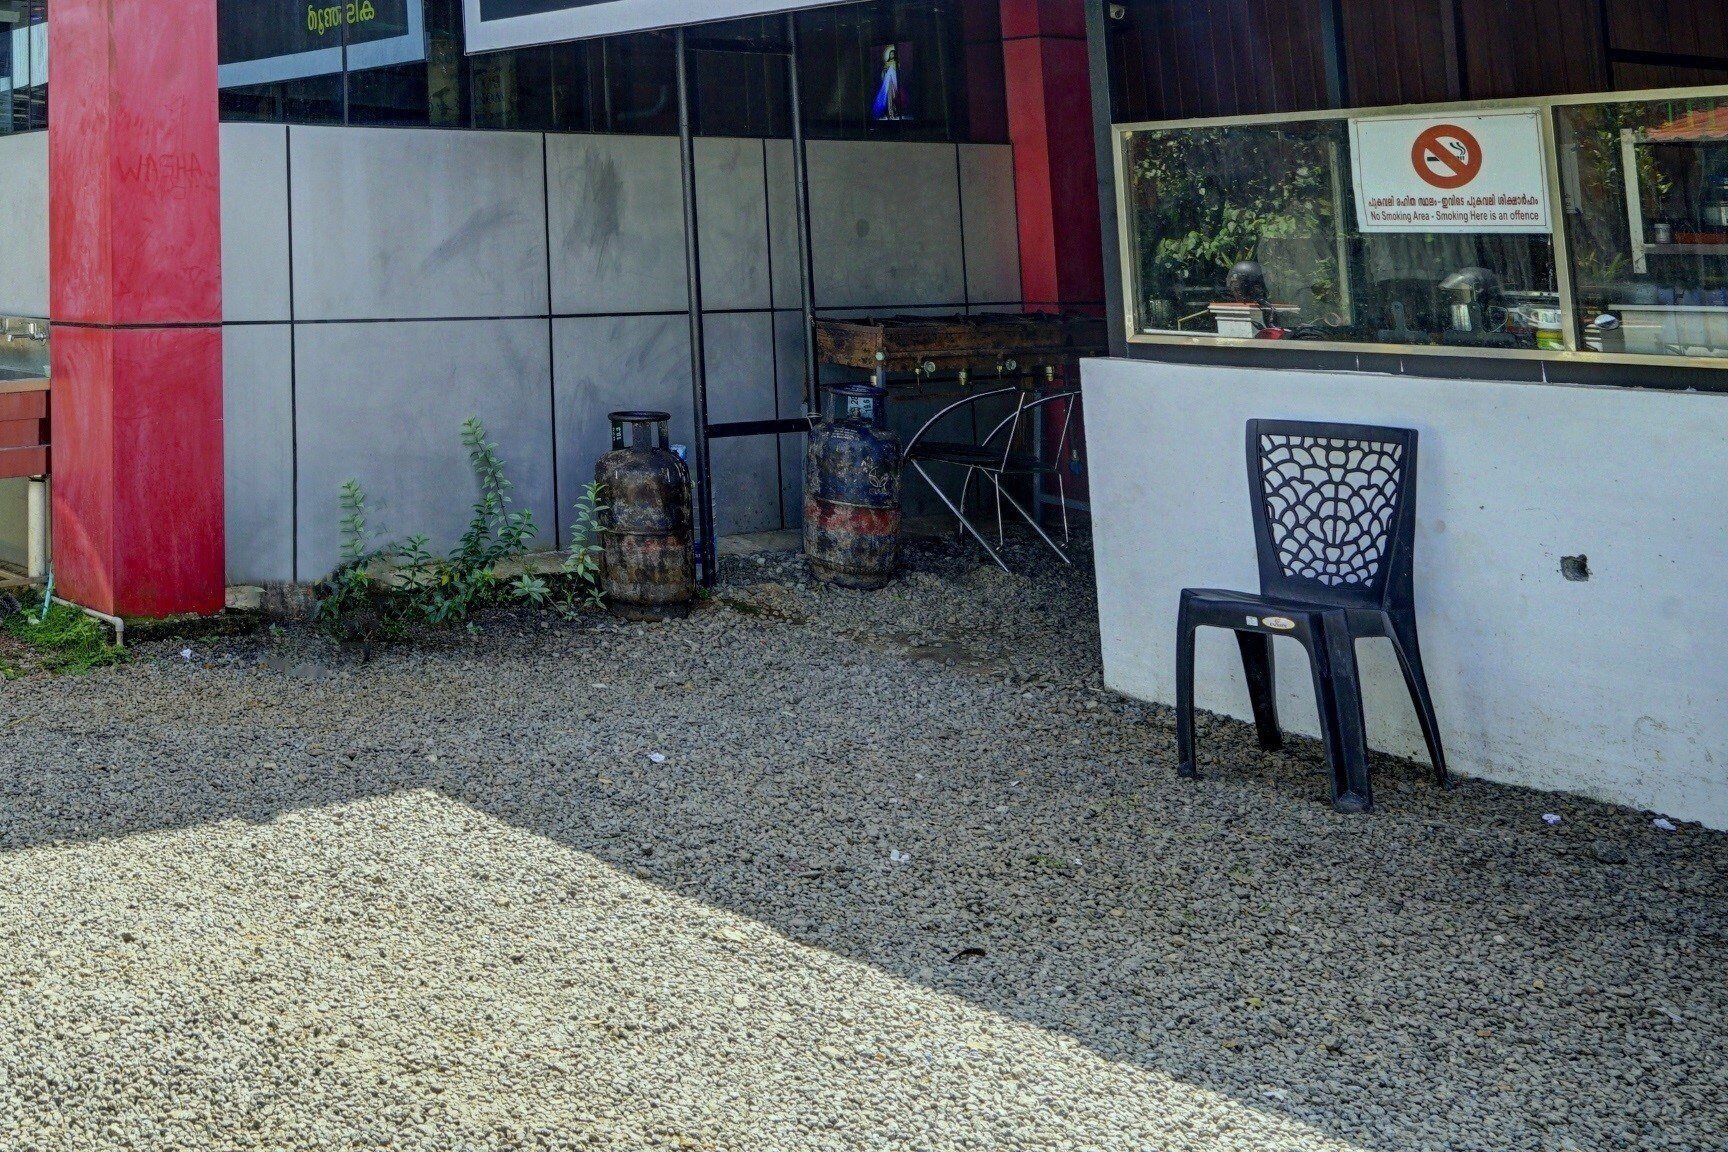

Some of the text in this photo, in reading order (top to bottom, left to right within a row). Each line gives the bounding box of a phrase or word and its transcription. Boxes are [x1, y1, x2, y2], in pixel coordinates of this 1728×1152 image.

[1371, 211, 1381, 221] No
[1381, 210, 1412, 223] Smoking
[1412, 211, 1430, 220] Area
[1435, 210, 1469, 223] Smoking
[1470, 210, 1488, 220] Here
[1489, 210, 1497, 220] is
[1509, 210, 1539, 220] offence
